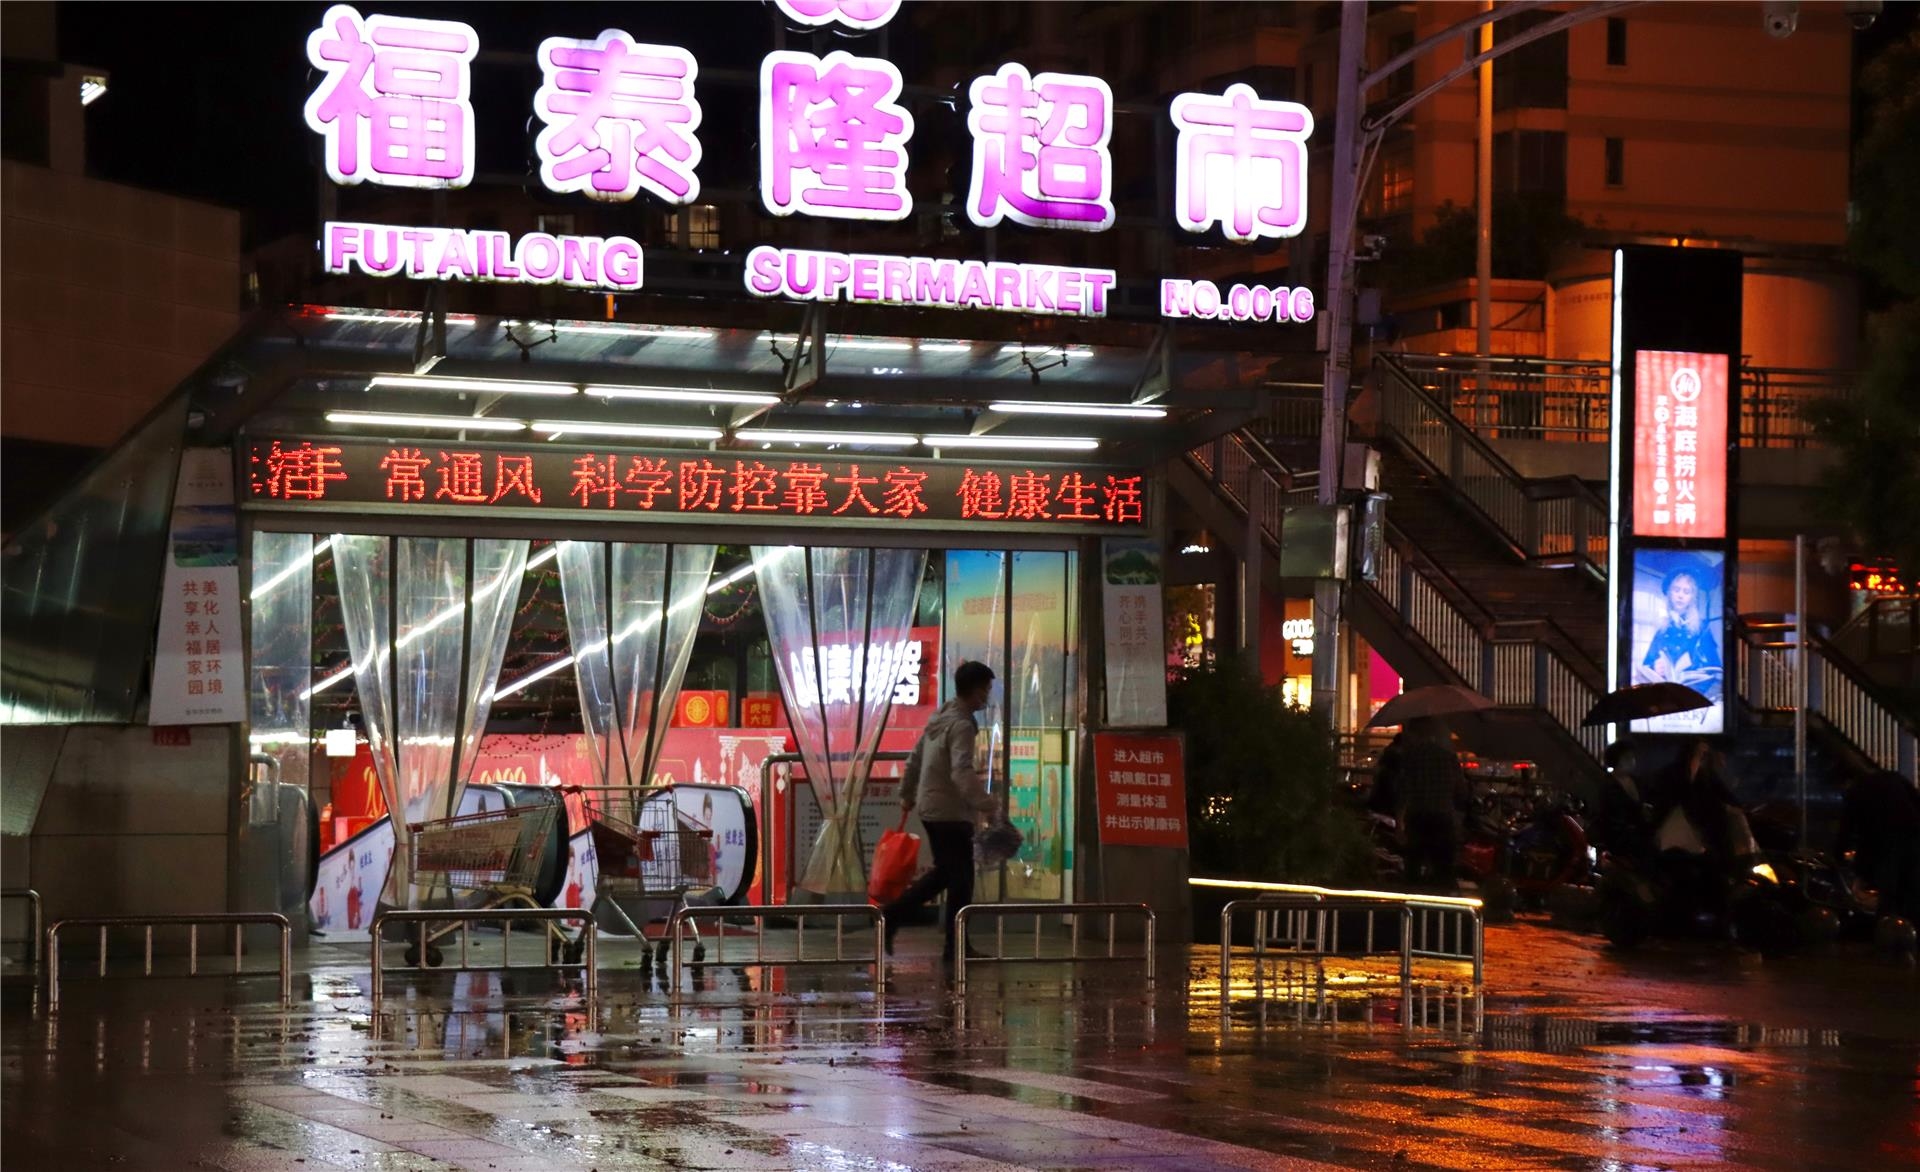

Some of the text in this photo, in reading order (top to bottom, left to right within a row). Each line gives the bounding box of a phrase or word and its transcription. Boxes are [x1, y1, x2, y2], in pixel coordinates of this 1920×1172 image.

[305, 5, 1314, 240] 福泰隆超市
[320, 222, 1315, 322] FUTAILONG SUPERMARKET NO.0016
[380, 448, 541, 504] 常通风
[571, 454, 928, 518] 科学防控靠大家
[956, 467, 1142, 523] 健康生活
[1674, 404, 1698, 525] 海底捞火锅
[183, 580, 204, 695] 共享幸福家园
[203, 580, 223, 695] 美化人居环境
[1109, 771, 1171, 786] 请佩戴口罩
[1114, 749, 1164, 764] 进入超市
[1106, 815, 1181, 832] 并出示健康码
[1116, 793, 1167, 809] 测量体温
